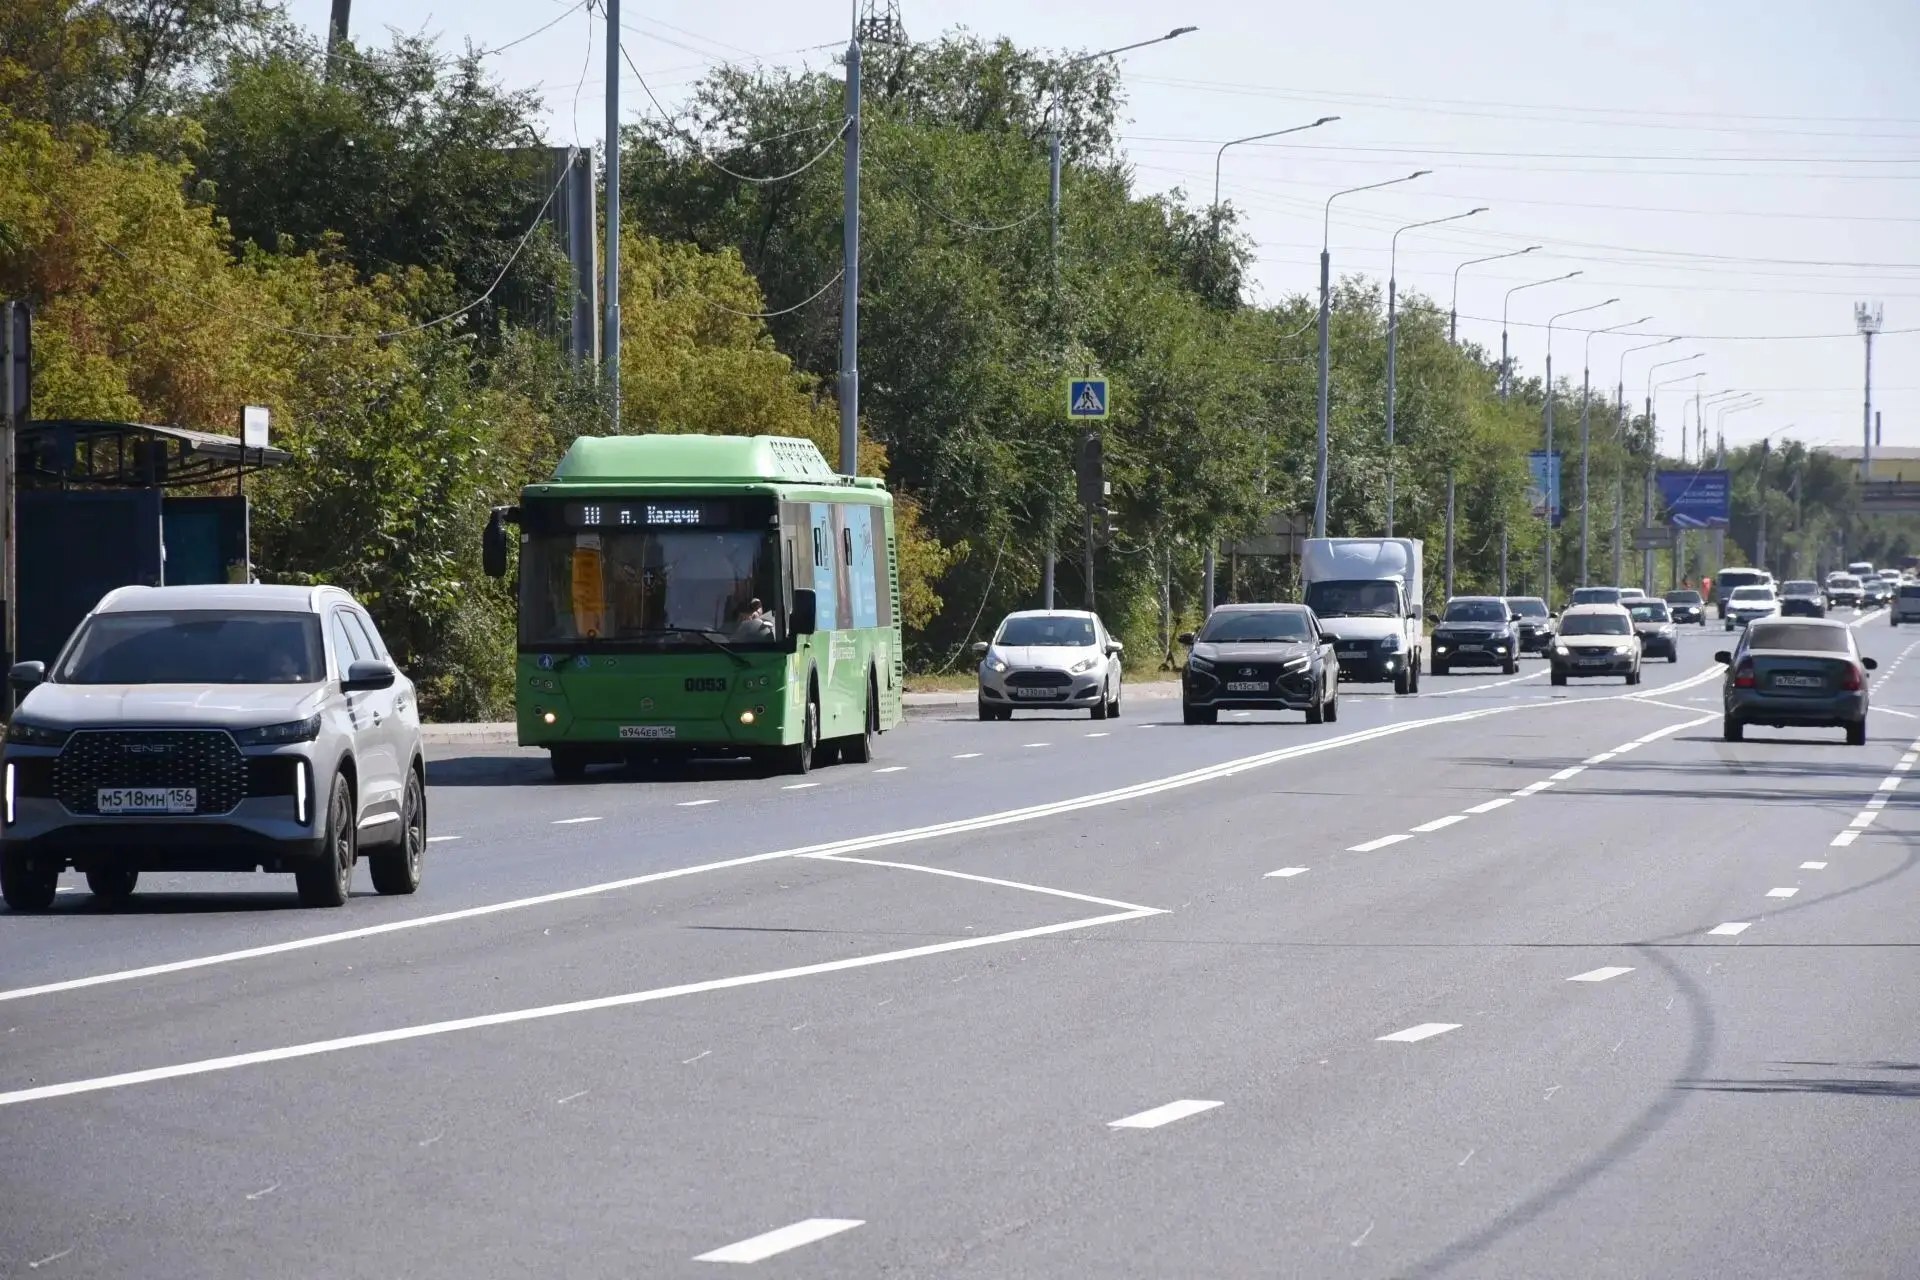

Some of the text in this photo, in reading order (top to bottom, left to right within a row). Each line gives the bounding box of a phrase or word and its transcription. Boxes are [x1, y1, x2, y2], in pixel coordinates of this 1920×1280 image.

[620, 510, 637, 525] п.
[647, 505, 700, 524] Карачи
[684, 677, 727, 692] 0053
[120, 743, 177, 753] TENET
[102, 789, 193, 807] М518МН 156
